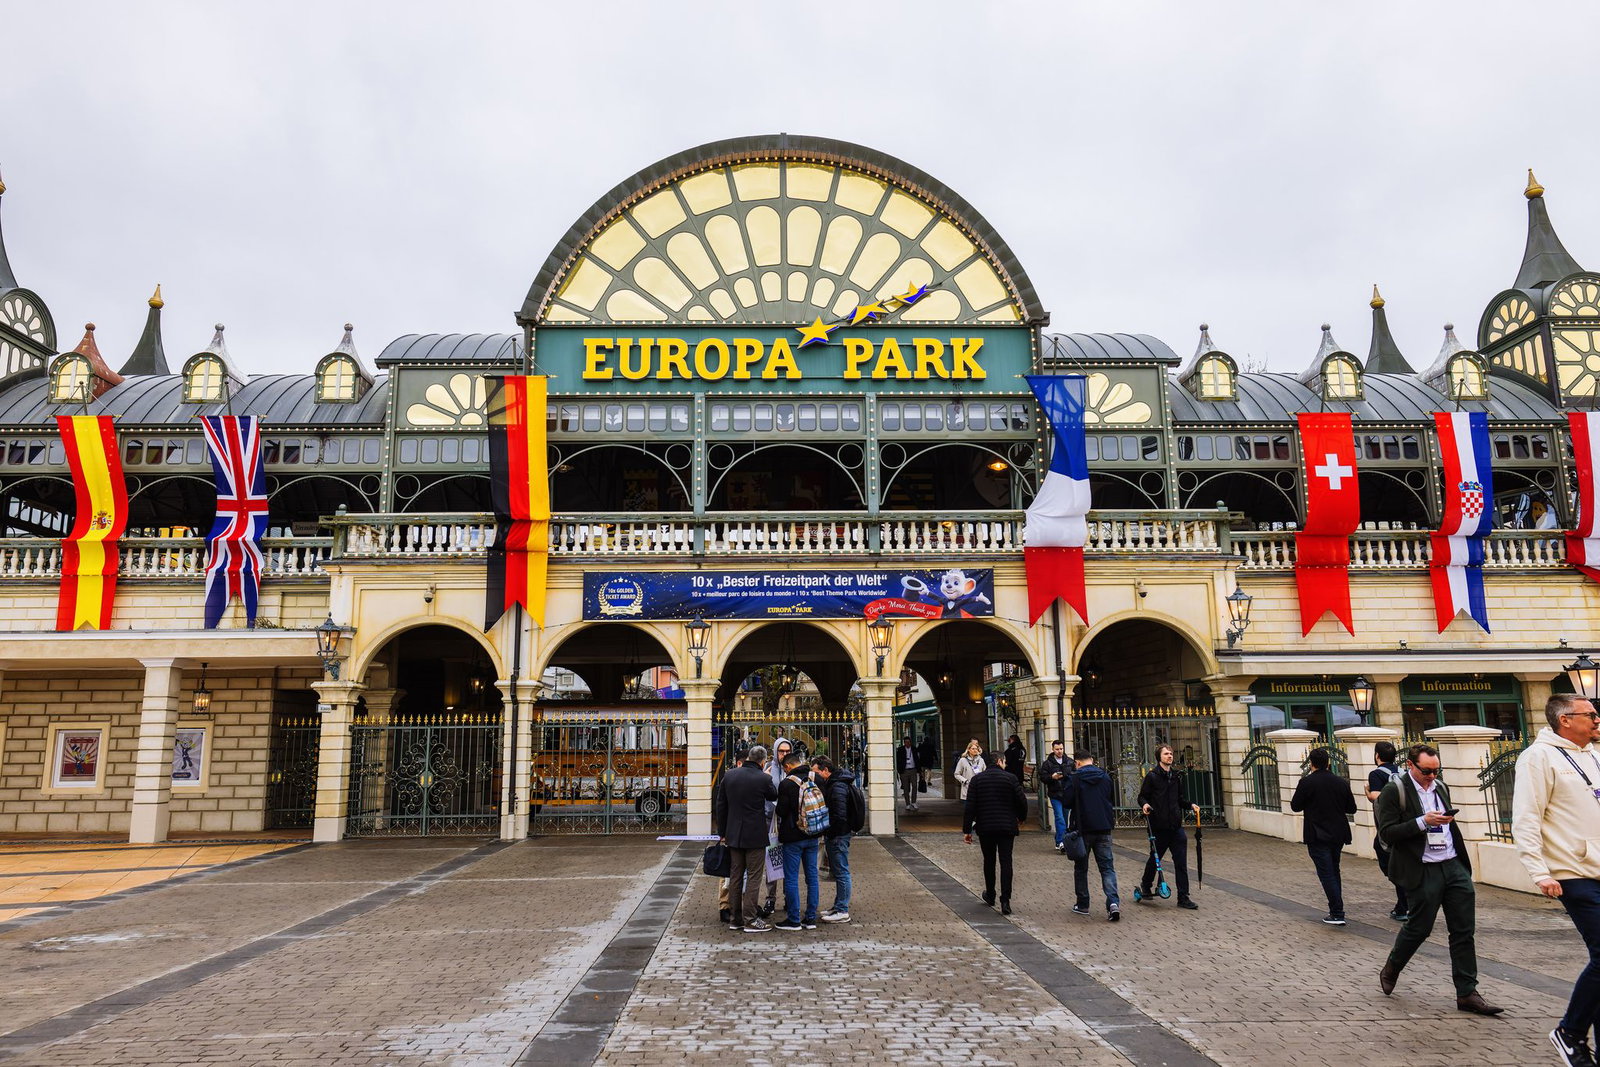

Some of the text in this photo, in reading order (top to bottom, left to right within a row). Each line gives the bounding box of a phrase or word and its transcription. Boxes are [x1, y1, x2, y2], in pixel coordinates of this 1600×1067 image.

[582, 337, 987, 381] EUROPA PARK
[691, 576, 704, 587] 10
[717, 575, 760, 589] „Bester
[763, 574, 831, 588] Freizeitpark
[834, 574, 853, 586] der
[856, 574, 887, 586] Welt“
[867, 603, 885, 614] Danke
[888, 600, 906, 609] Merci
[909, 603, 925, 614] Thank
[1270, 682, 1341, 693] Information
[1421, 680, 1491, 691] Information
